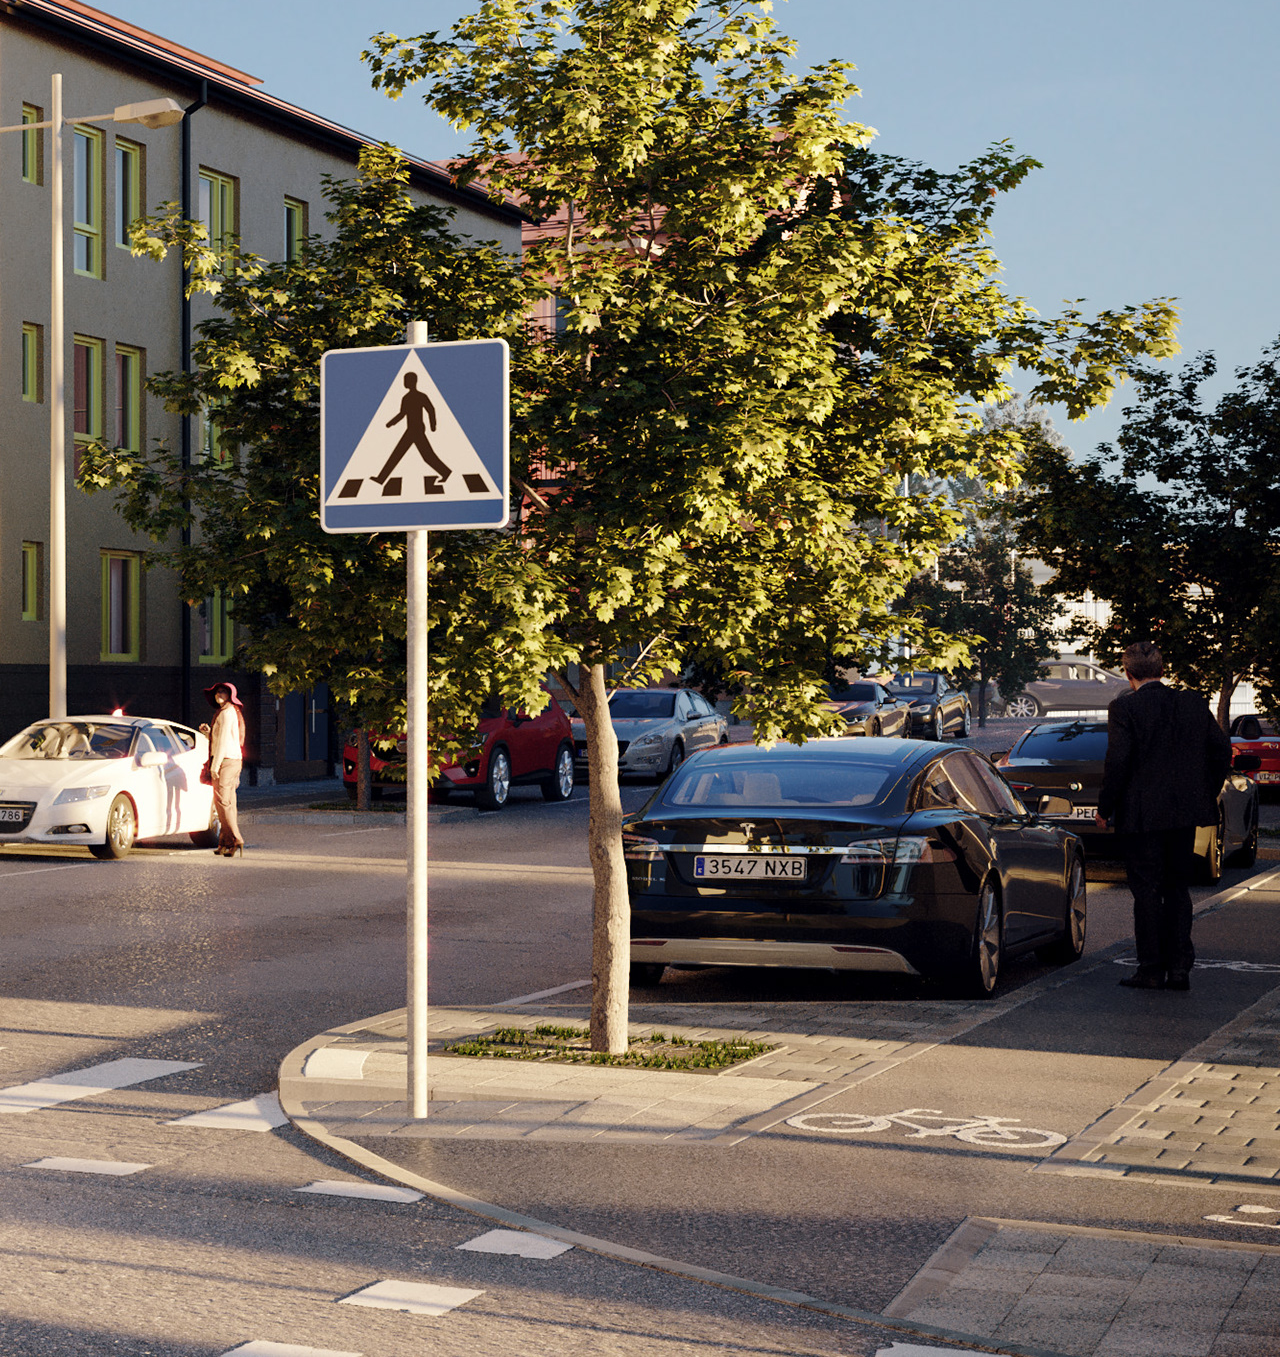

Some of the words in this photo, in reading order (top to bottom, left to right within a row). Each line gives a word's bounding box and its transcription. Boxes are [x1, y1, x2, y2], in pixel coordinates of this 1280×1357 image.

[1, 810, 21, 820] 786
[709, 859, 758, 875] 3547
[765, 860, 803, 876] NXB
